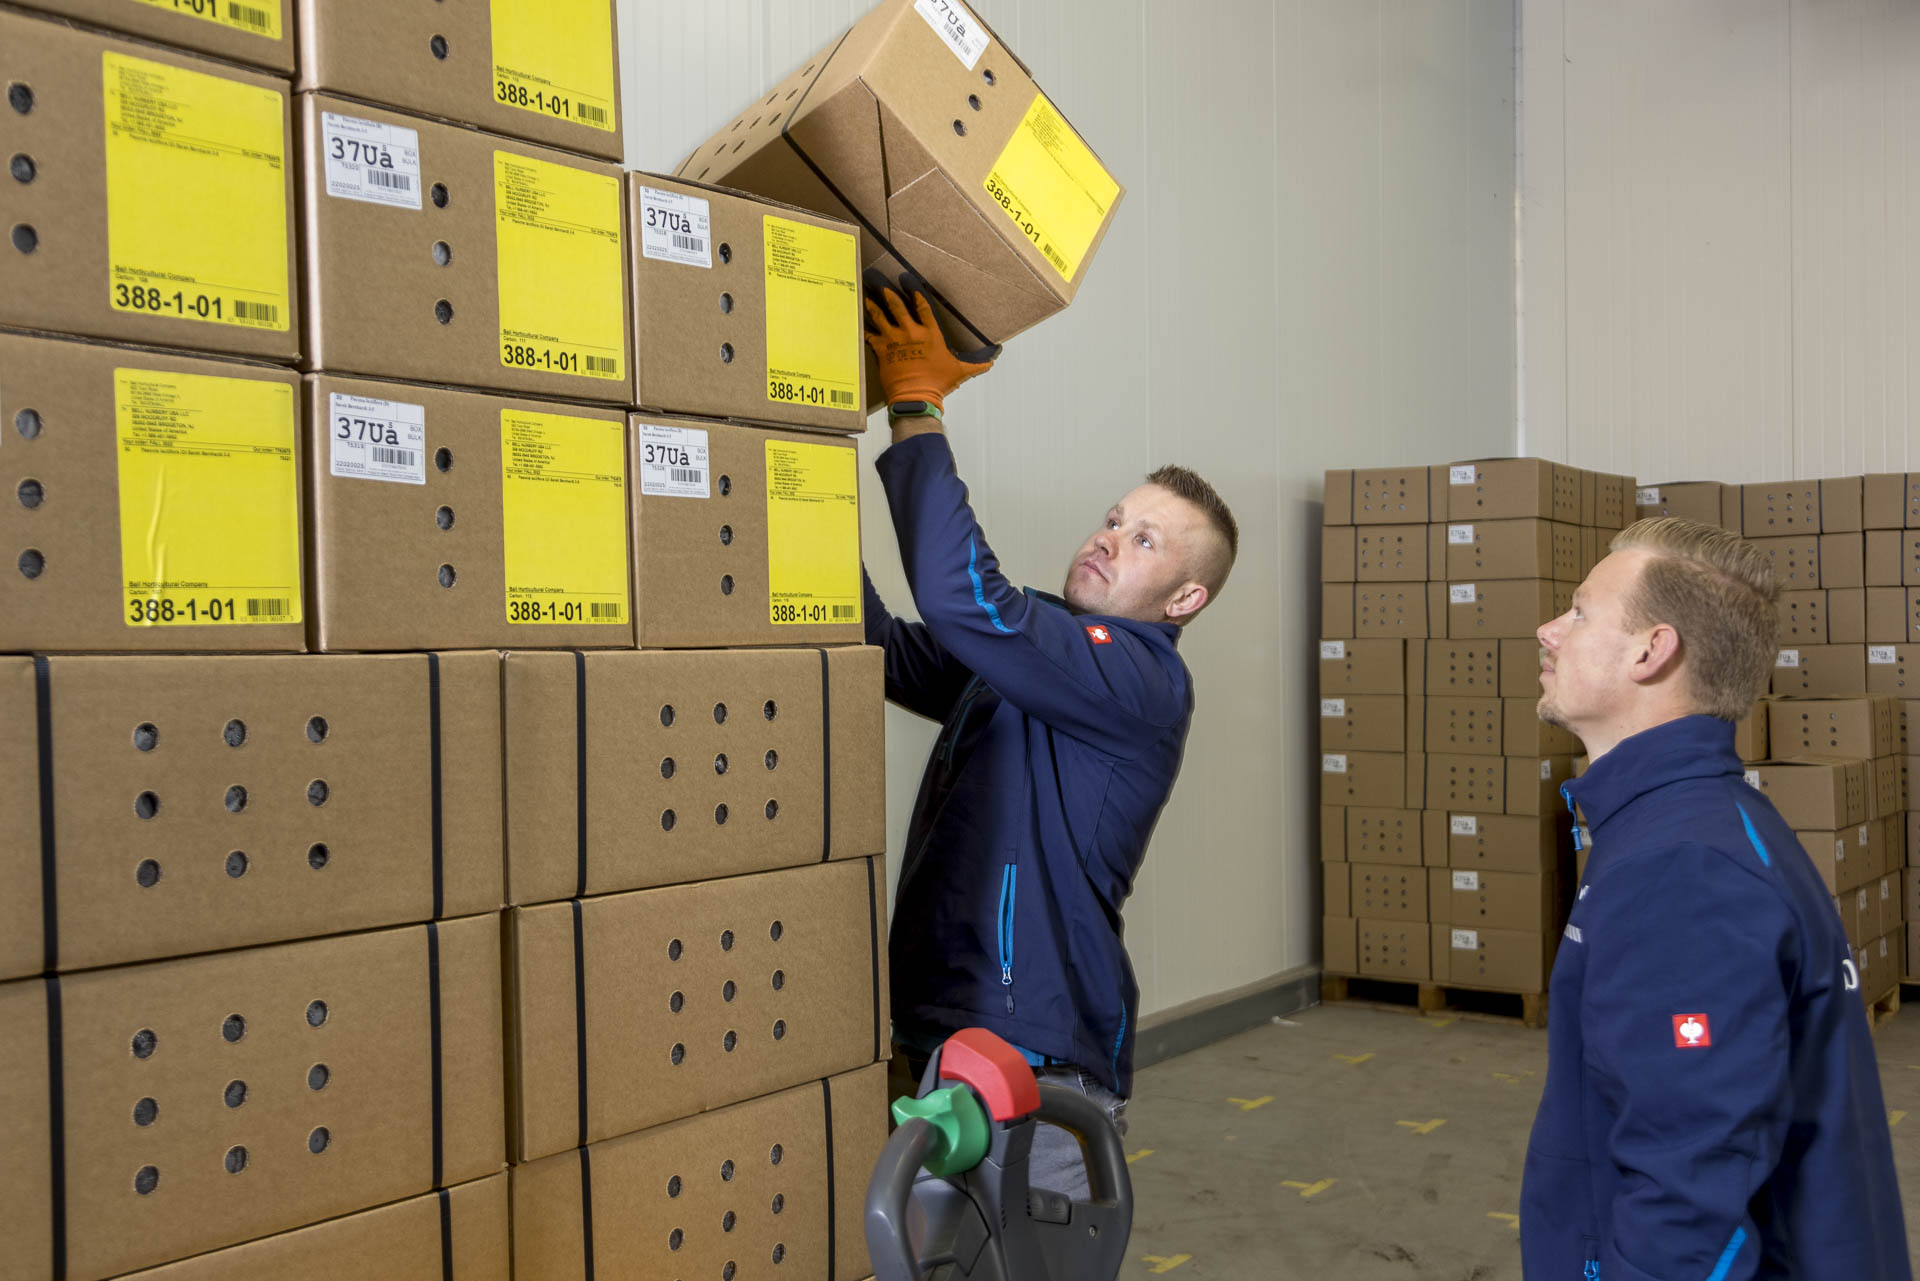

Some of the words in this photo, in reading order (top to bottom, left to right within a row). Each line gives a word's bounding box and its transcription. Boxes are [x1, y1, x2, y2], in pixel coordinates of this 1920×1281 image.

[497, 81, 569, 117] 388-1-01
[987, 179, 1041, 243] 388-1-01
[115, 281, 221, 319] 388-1-01
[503, 342, 576, 372] 388-1-01
[769, 380, 824, 404] 388-1-01
[180, 580, 207, 588] Company
[129, 597, 234, 622] 388-1-01
[509, 600, 582, 620] 388-1-01
[772, 604, 826, 621] 388-1-01
